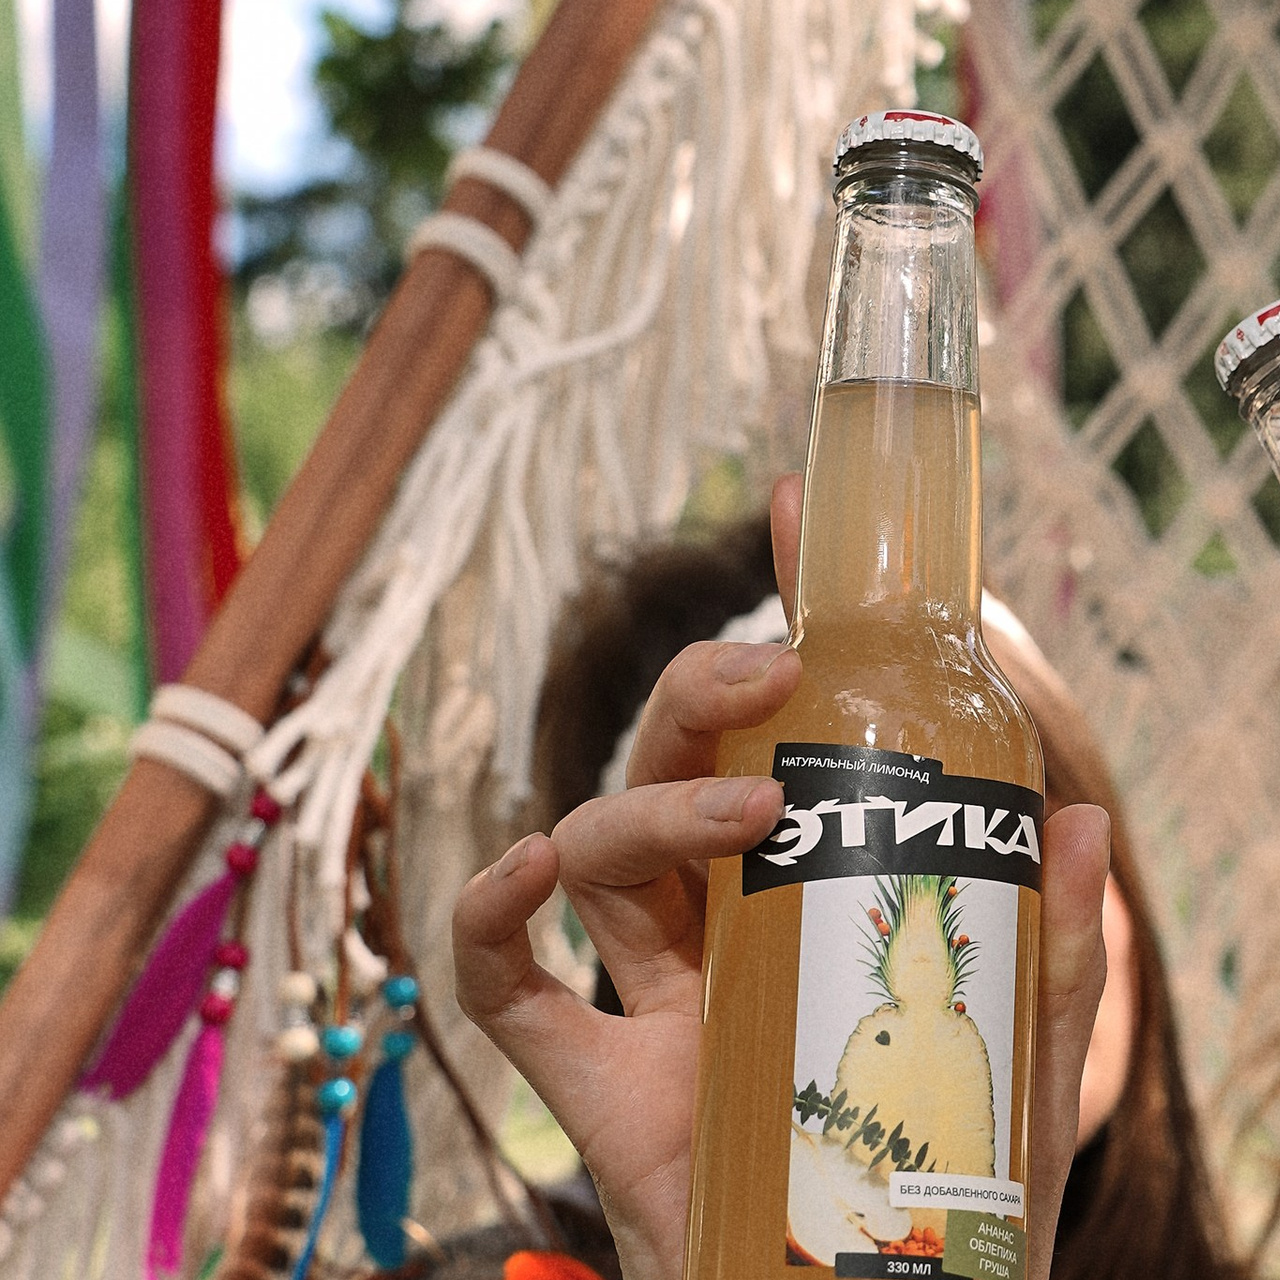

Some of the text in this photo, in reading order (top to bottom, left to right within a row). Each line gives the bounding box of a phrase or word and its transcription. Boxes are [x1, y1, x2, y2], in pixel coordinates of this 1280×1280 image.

[781, 756, 930, 784] НАТУРАЛЬНЫЙ ЛИМОНАД
[758, 795, 1041, 866] ЭТИКА
[900, 1185, 1021, 1205] БЕЗ ДОБАВЛЕННОГО САХАРА
[978, 1222, 1014, 1245] АНАНАС
[969, 1237, 1018, 1264] ОБЛЕПИХА
[887, 1261, 931, 1275] 330 МЛ
[979, 1258, 1010, 1279] ГРУША
